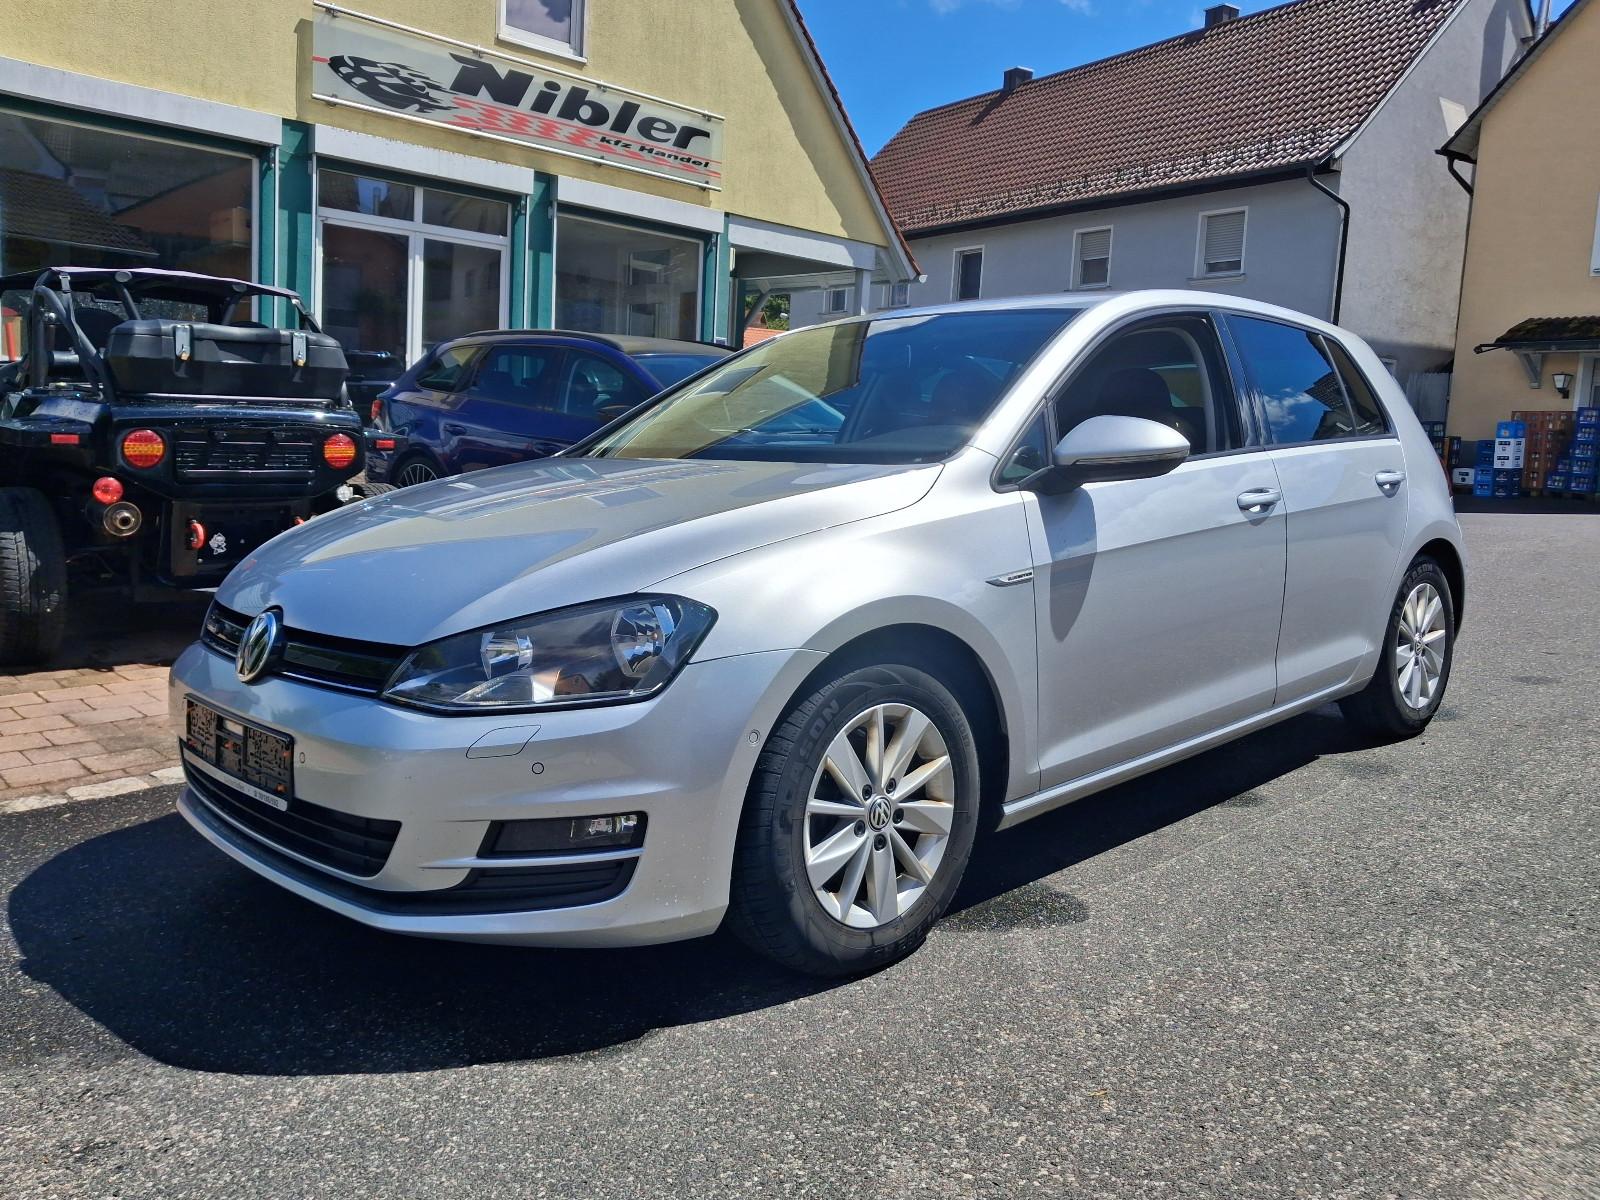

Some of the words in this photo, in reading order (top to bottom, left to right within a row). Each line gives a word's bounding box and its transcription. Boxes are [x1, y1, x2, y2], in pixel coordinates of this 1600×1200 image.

[449, 52, 711, 149] Nibler
[599, 136, 633, 149] kfz
[638, 145, 710, 168] Handel
